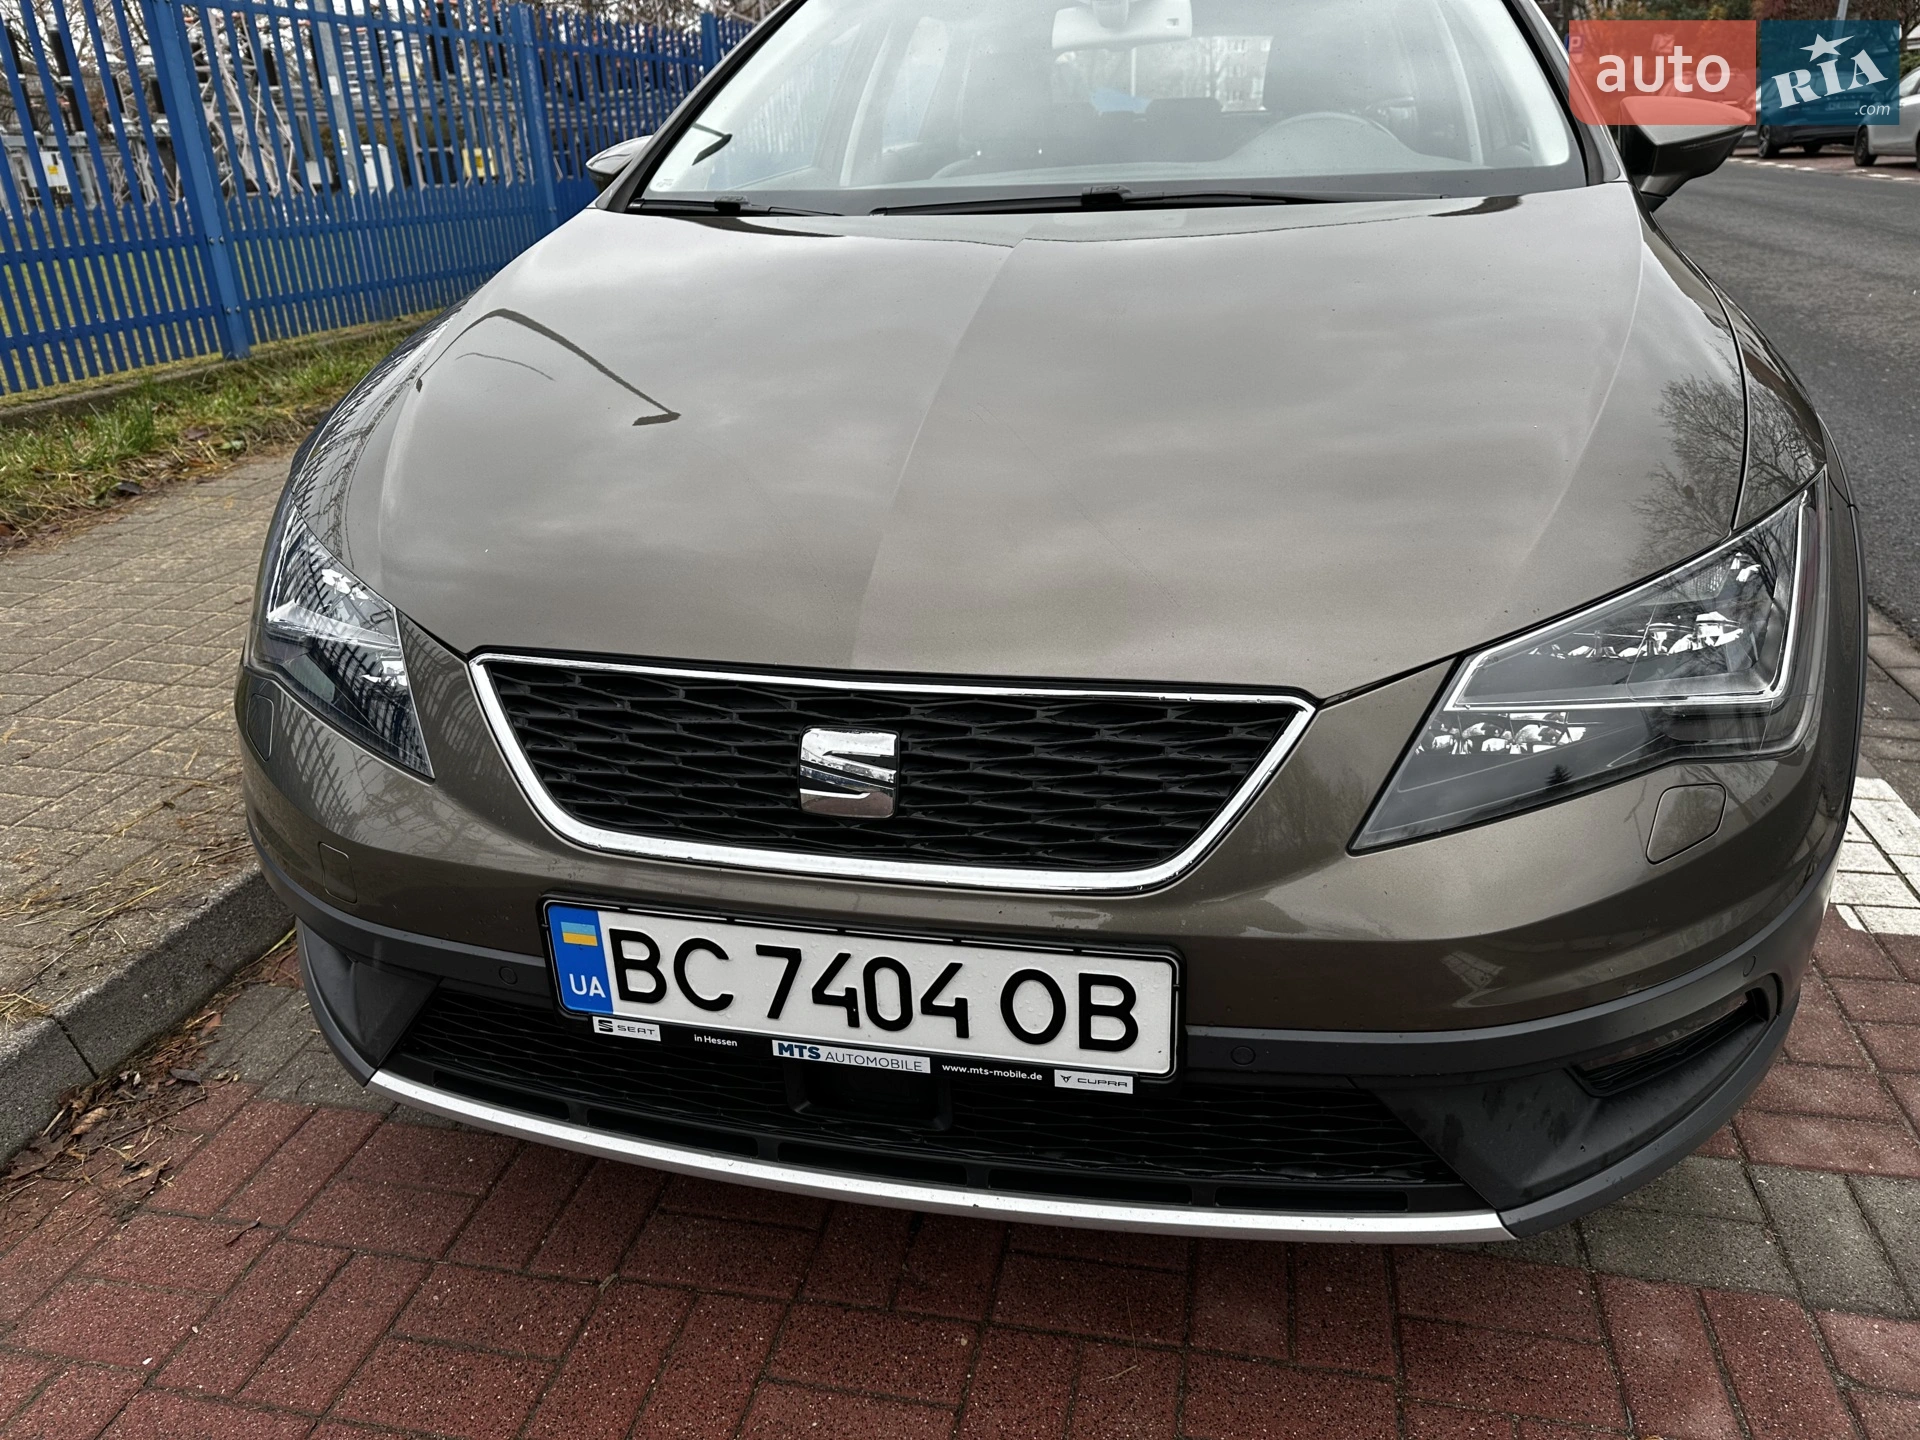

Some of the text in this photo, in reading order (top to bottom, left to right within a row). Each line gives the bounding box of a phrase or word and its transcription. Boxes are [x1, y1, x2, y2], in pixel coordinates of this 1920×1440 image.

[569, 973, 606, 999] UA
[608, 927, 1139, 1052] BC 7404 OB
[617, 1024, 656, 1036] SEAT
[693, 1034, 738, 1047] in Hessen
[777, 1042, 923, 1072] MTS AUTOMOBILE
[941, 1063, 1043, 1081] www.mts-mobile.de
[1077, 1077, 1128, 1088] CUPRA
